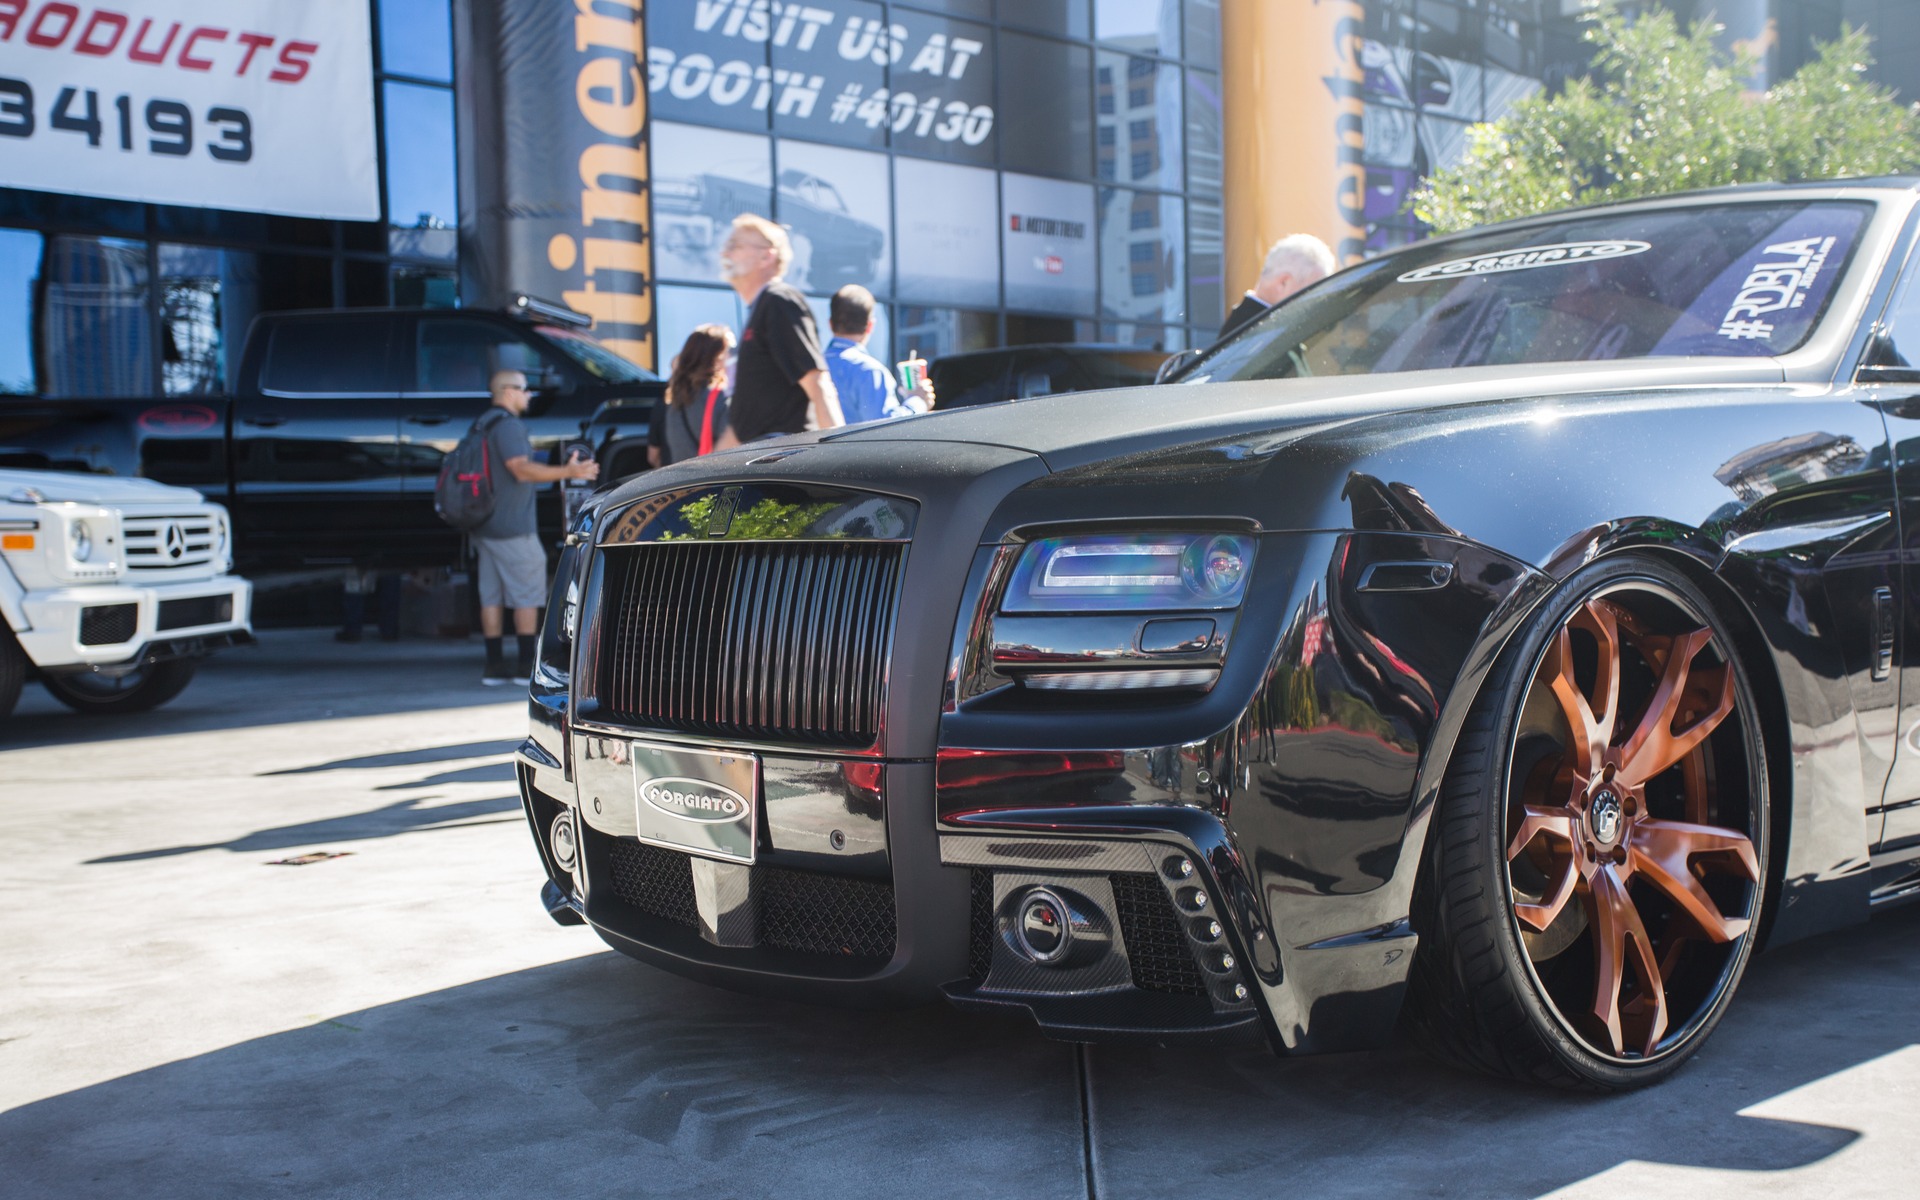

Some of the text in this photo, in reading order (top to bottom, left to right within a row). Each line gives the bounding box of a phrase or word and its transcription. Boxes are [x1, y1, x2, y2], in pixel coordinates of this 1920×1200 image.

[693, 0, 983, 79] VISIT US AT
[0, 77, 253, 162] 34193
[830, 83, 994, 146] #40130
[650, 787, 738, 813] FORGIATO
